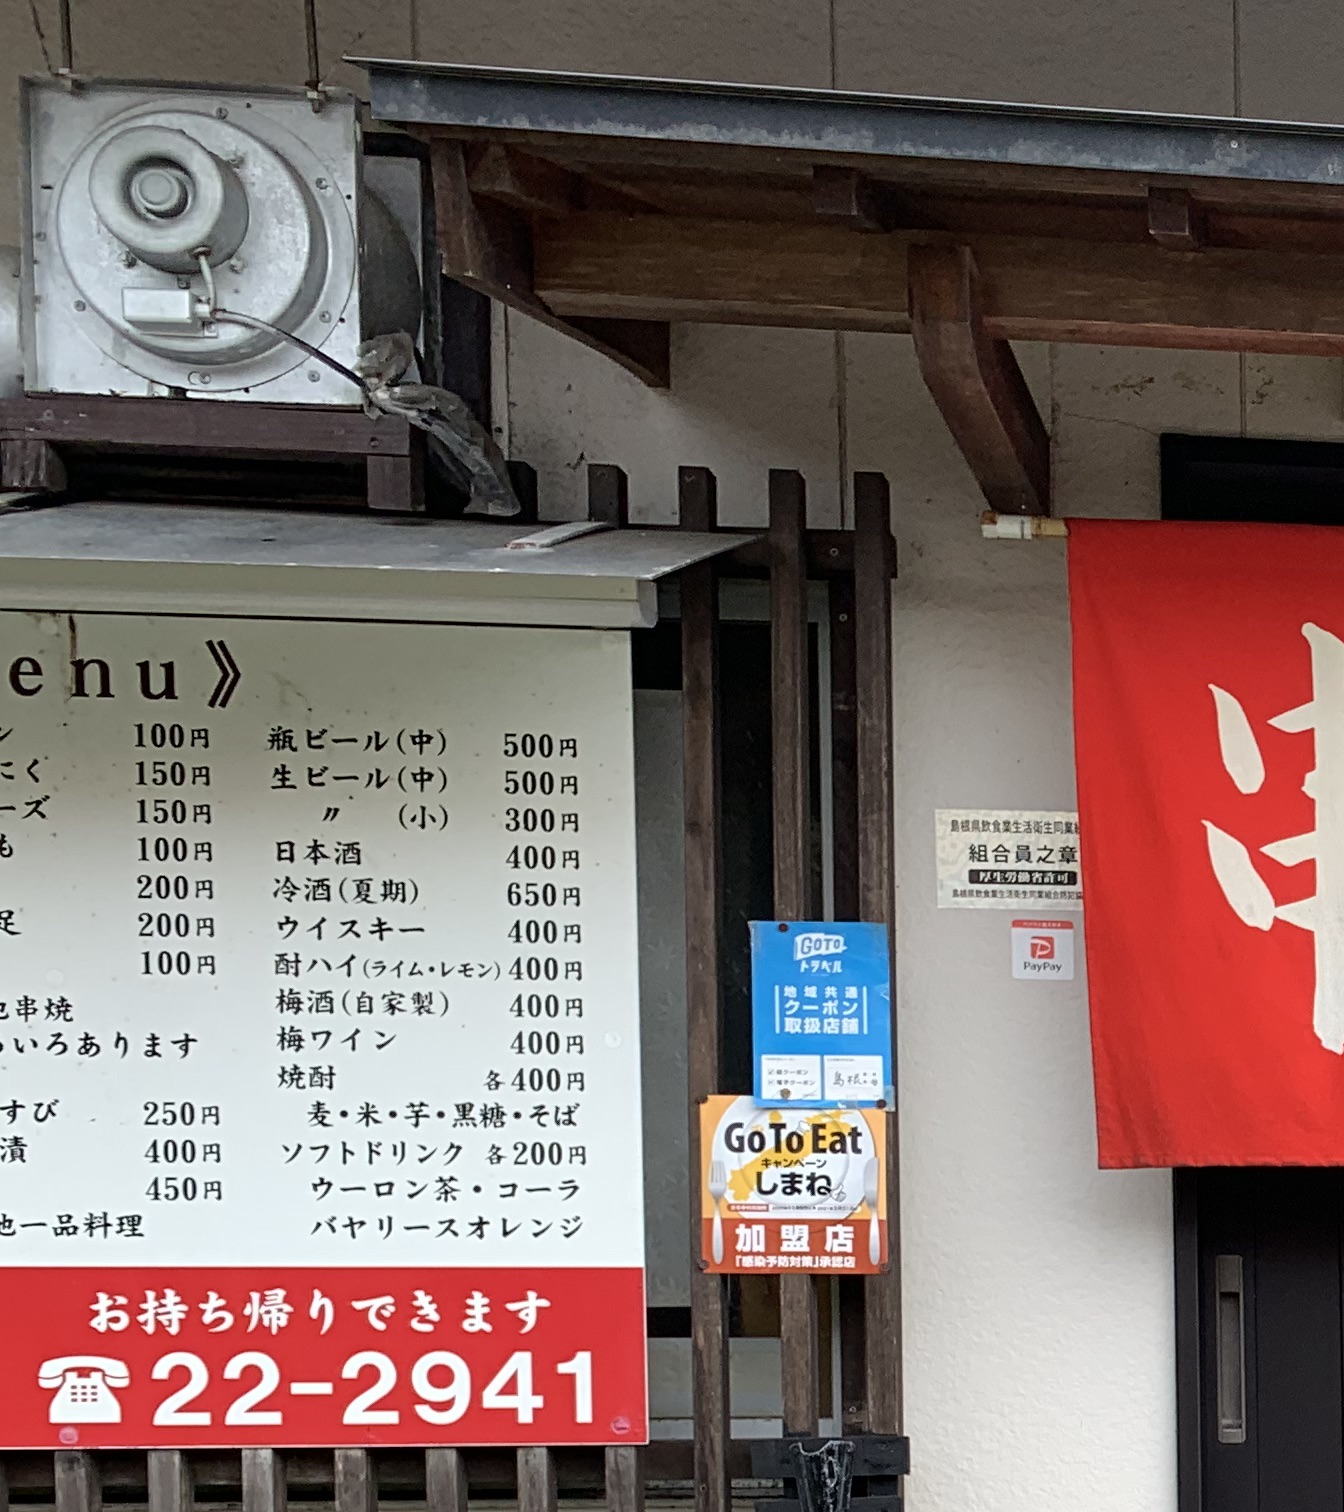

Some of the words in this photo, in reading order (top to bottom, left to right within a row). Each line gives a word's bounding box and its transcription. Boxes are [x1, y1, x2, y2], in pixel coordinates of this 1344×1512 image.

[134, 722, 209, 749] 100円
[503, 733, 578, 758] 500円
[135, 761, 210, 786] 150円
[504, 771, 579, 796] 500円
[137, 799, 212, 824] 150円
[505, 808, 580, 833] 300円
[138, 837, 213, 862] 100円
[276, 838, 362, 866] 日本酒
[505, 845, 580, 870] 400円
[968, 843, 1078, 864] 組合員之章
[137, 875, 214, 900] 200円
[272, 875, 419, 904] 冷酒(夏期)
[507, 882, 581, 907] 650円
[138, 913, 215, 938] 200円
[277, 915, 425, 941] ウイスキー
[507, 920, 582, 944] 400円
[141, 951, 216, 976] 100円
[508, 957, 583, 981] 400円
[800, 959, 843, 974] トラベル
[1023, 961, 1062, 973] PayPay
[275, 988, 449, 1016] 梅酒(自家製)
[509, 994, 584, 1018] 400円
[783, 1000, 859, 1016] クーポン
[783, 1017, 860, 1035] 取扱店舗
[0, 1031, 198, 1059] いろあります
[276, 1025, 397, 1053] 梅ワイン
[510, 1031, 585, 1055] 400円
[277, 1064, 336, 1090] 焼酎
[143, 1101, 220, 1126] 250円
[145, 1139, 221, 1163] 400円
[282, 1141, 463, 1166] ソフトドリンク
[761, 1158, 827, 1168] キャンペーン
[146, 1177, 222, 1201] 450円
[756, 1171, 832, 1196] しまね
[310, 1215, 584, 1240] バヤリースオレンジ
[735, 1223, 855, 1253] 加盟店
[88, 1287, 552, 1336] お持ち帰りできます
[151, 1350, 594, 1427] 22-2941
